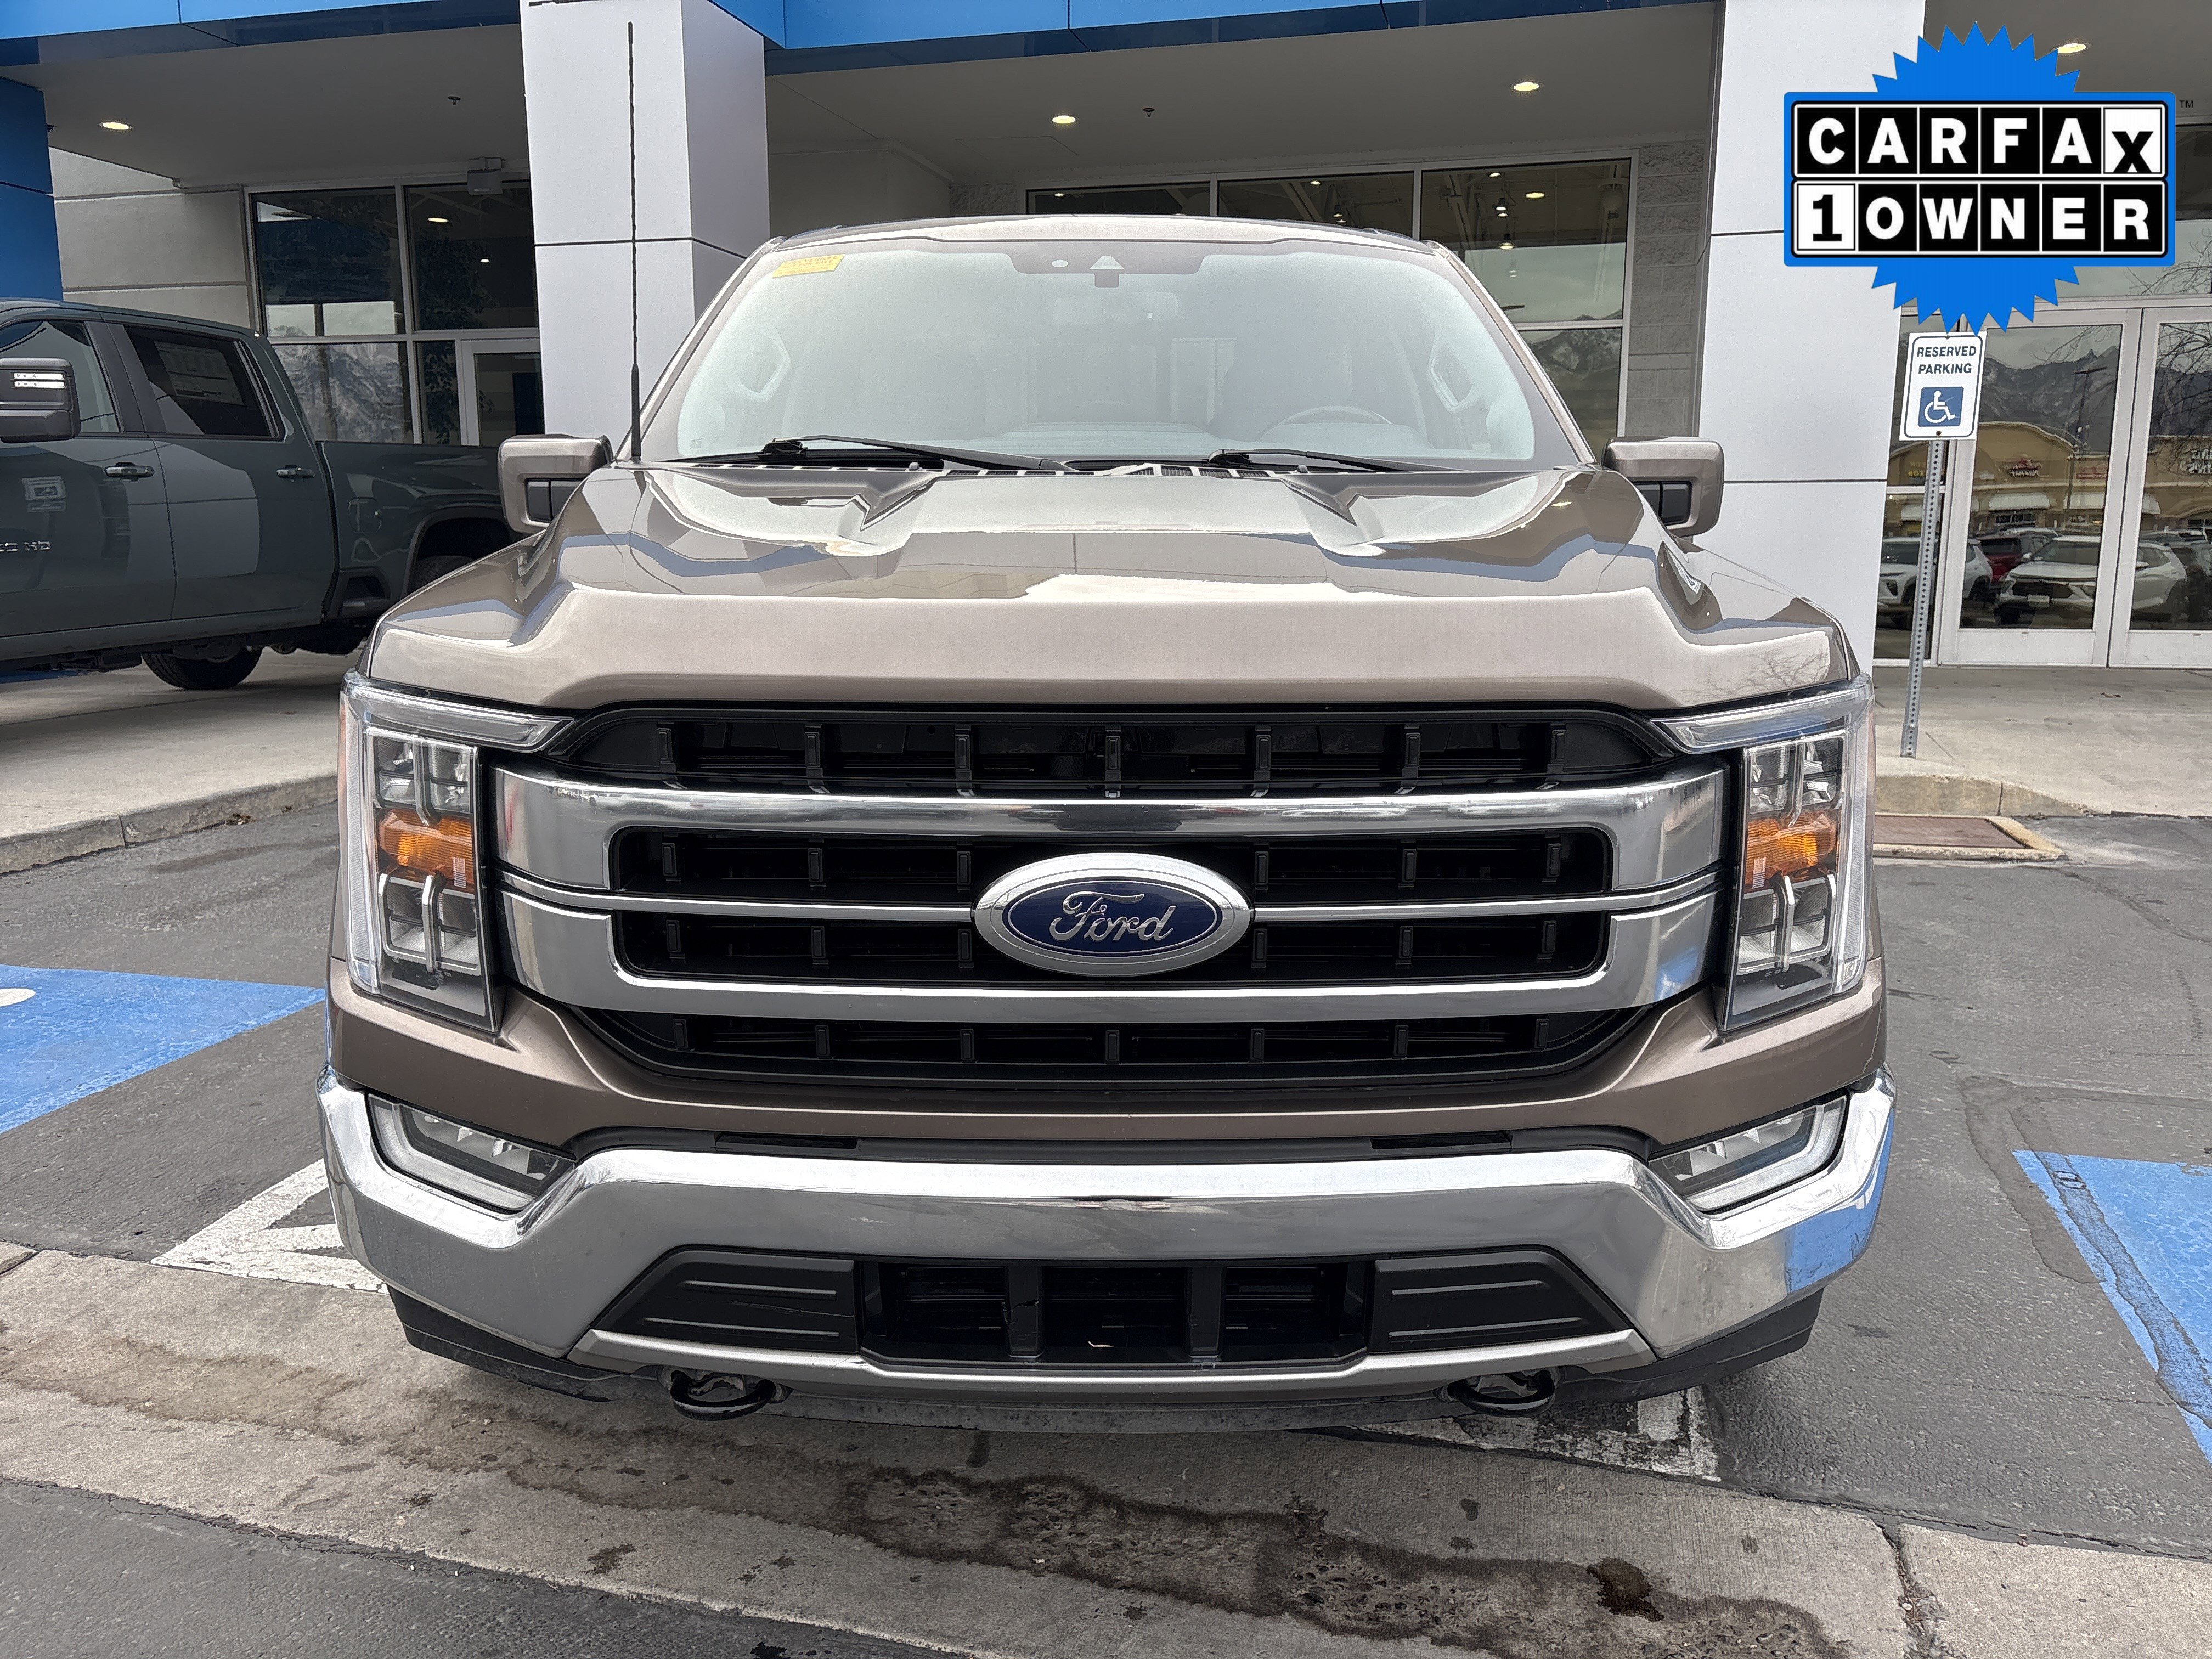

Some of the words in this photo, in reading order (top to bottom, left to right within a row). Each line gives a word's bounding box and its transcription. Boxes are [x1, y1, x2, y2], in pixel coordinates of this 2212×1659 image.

[1917, 346, 1977, 357] RESERVED
[1918, 363, 1972, 374] PARKING
[1049, 891, 1177, 942] Ford
